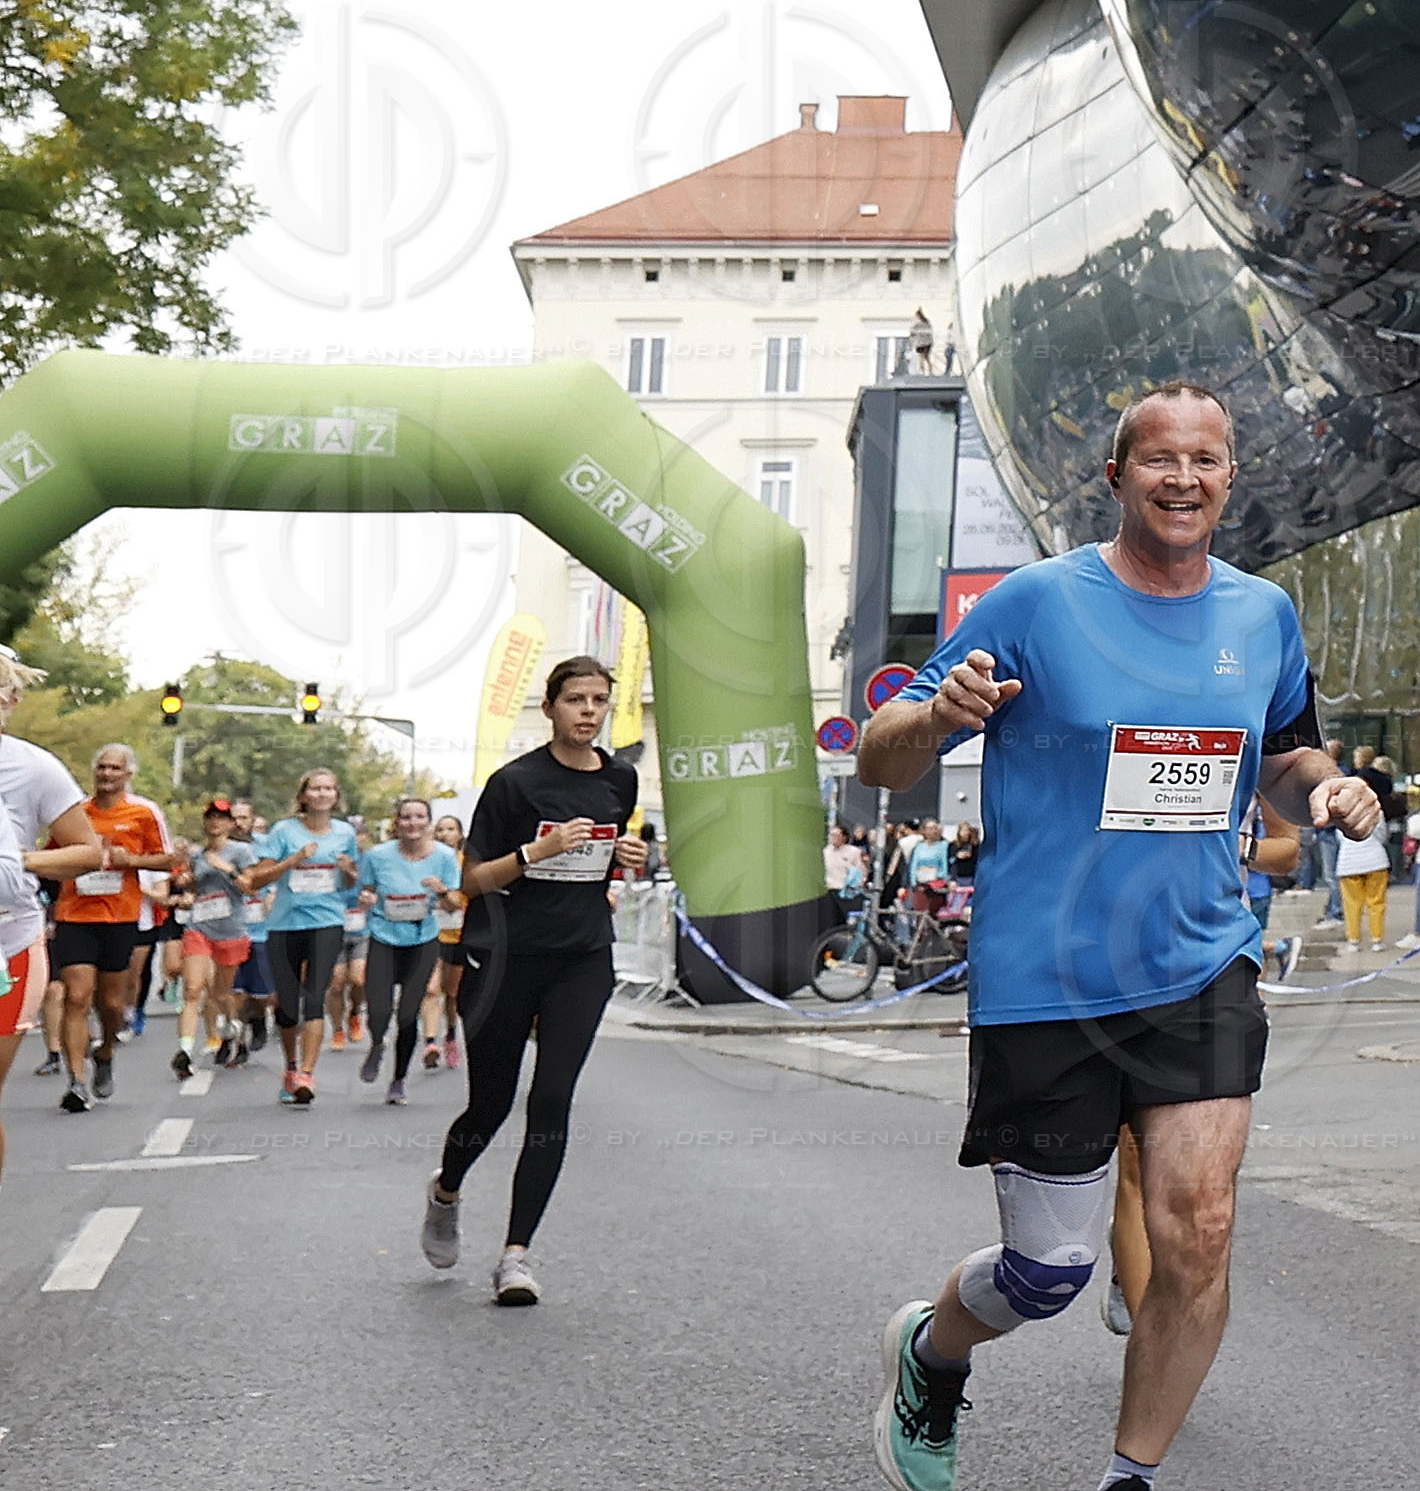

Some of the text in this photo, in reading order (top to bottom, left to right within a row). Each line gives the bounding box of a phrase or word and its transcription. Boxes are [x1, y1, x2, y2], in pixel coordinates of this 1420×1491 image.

[233, 420, 389, 452] GRAZ
[569, 464, 688, 565] GRAZ
[669, 741, 793, 778] GRAZ
[1148, 761, 1211, 785] 2559
[1154, 793, 1202, 804] Christian
